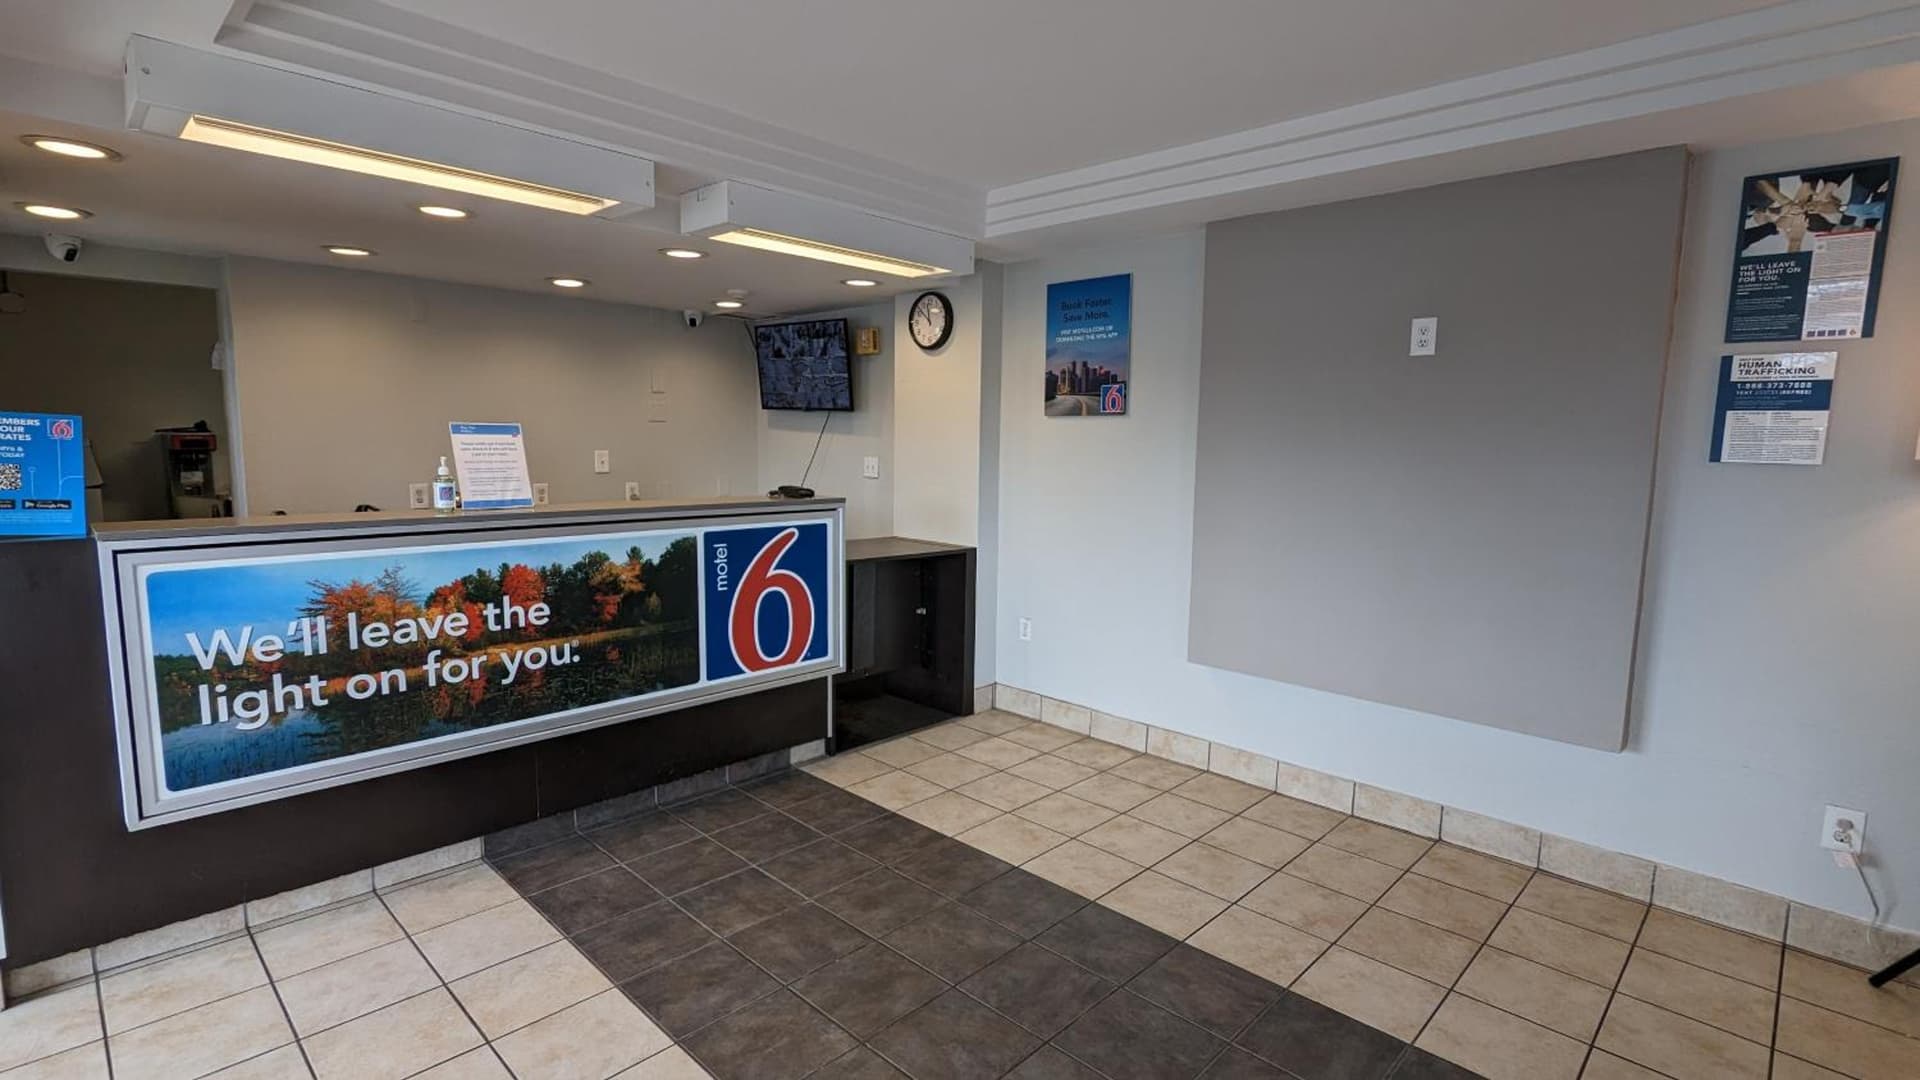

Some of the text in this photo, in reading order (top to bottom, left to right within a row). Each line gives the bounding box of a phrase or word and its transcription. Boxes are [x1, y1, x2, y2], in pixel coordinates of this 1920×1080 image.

[1740, 261, 1796, 271] WE'LL LEAVE
[1758, 268, 1784, 276] LIGHT
[1738, 367, 1816, 375] TRAFFICKING
[1105, 384, 1122, 412] 6
[713, 527, 815, 673] motel 6
[185, 595, 551, 670] We'll leave the
[199, 674, 329, 731] light
[345, 668, 407, 701] on
[423, 649, 488, 688] for
